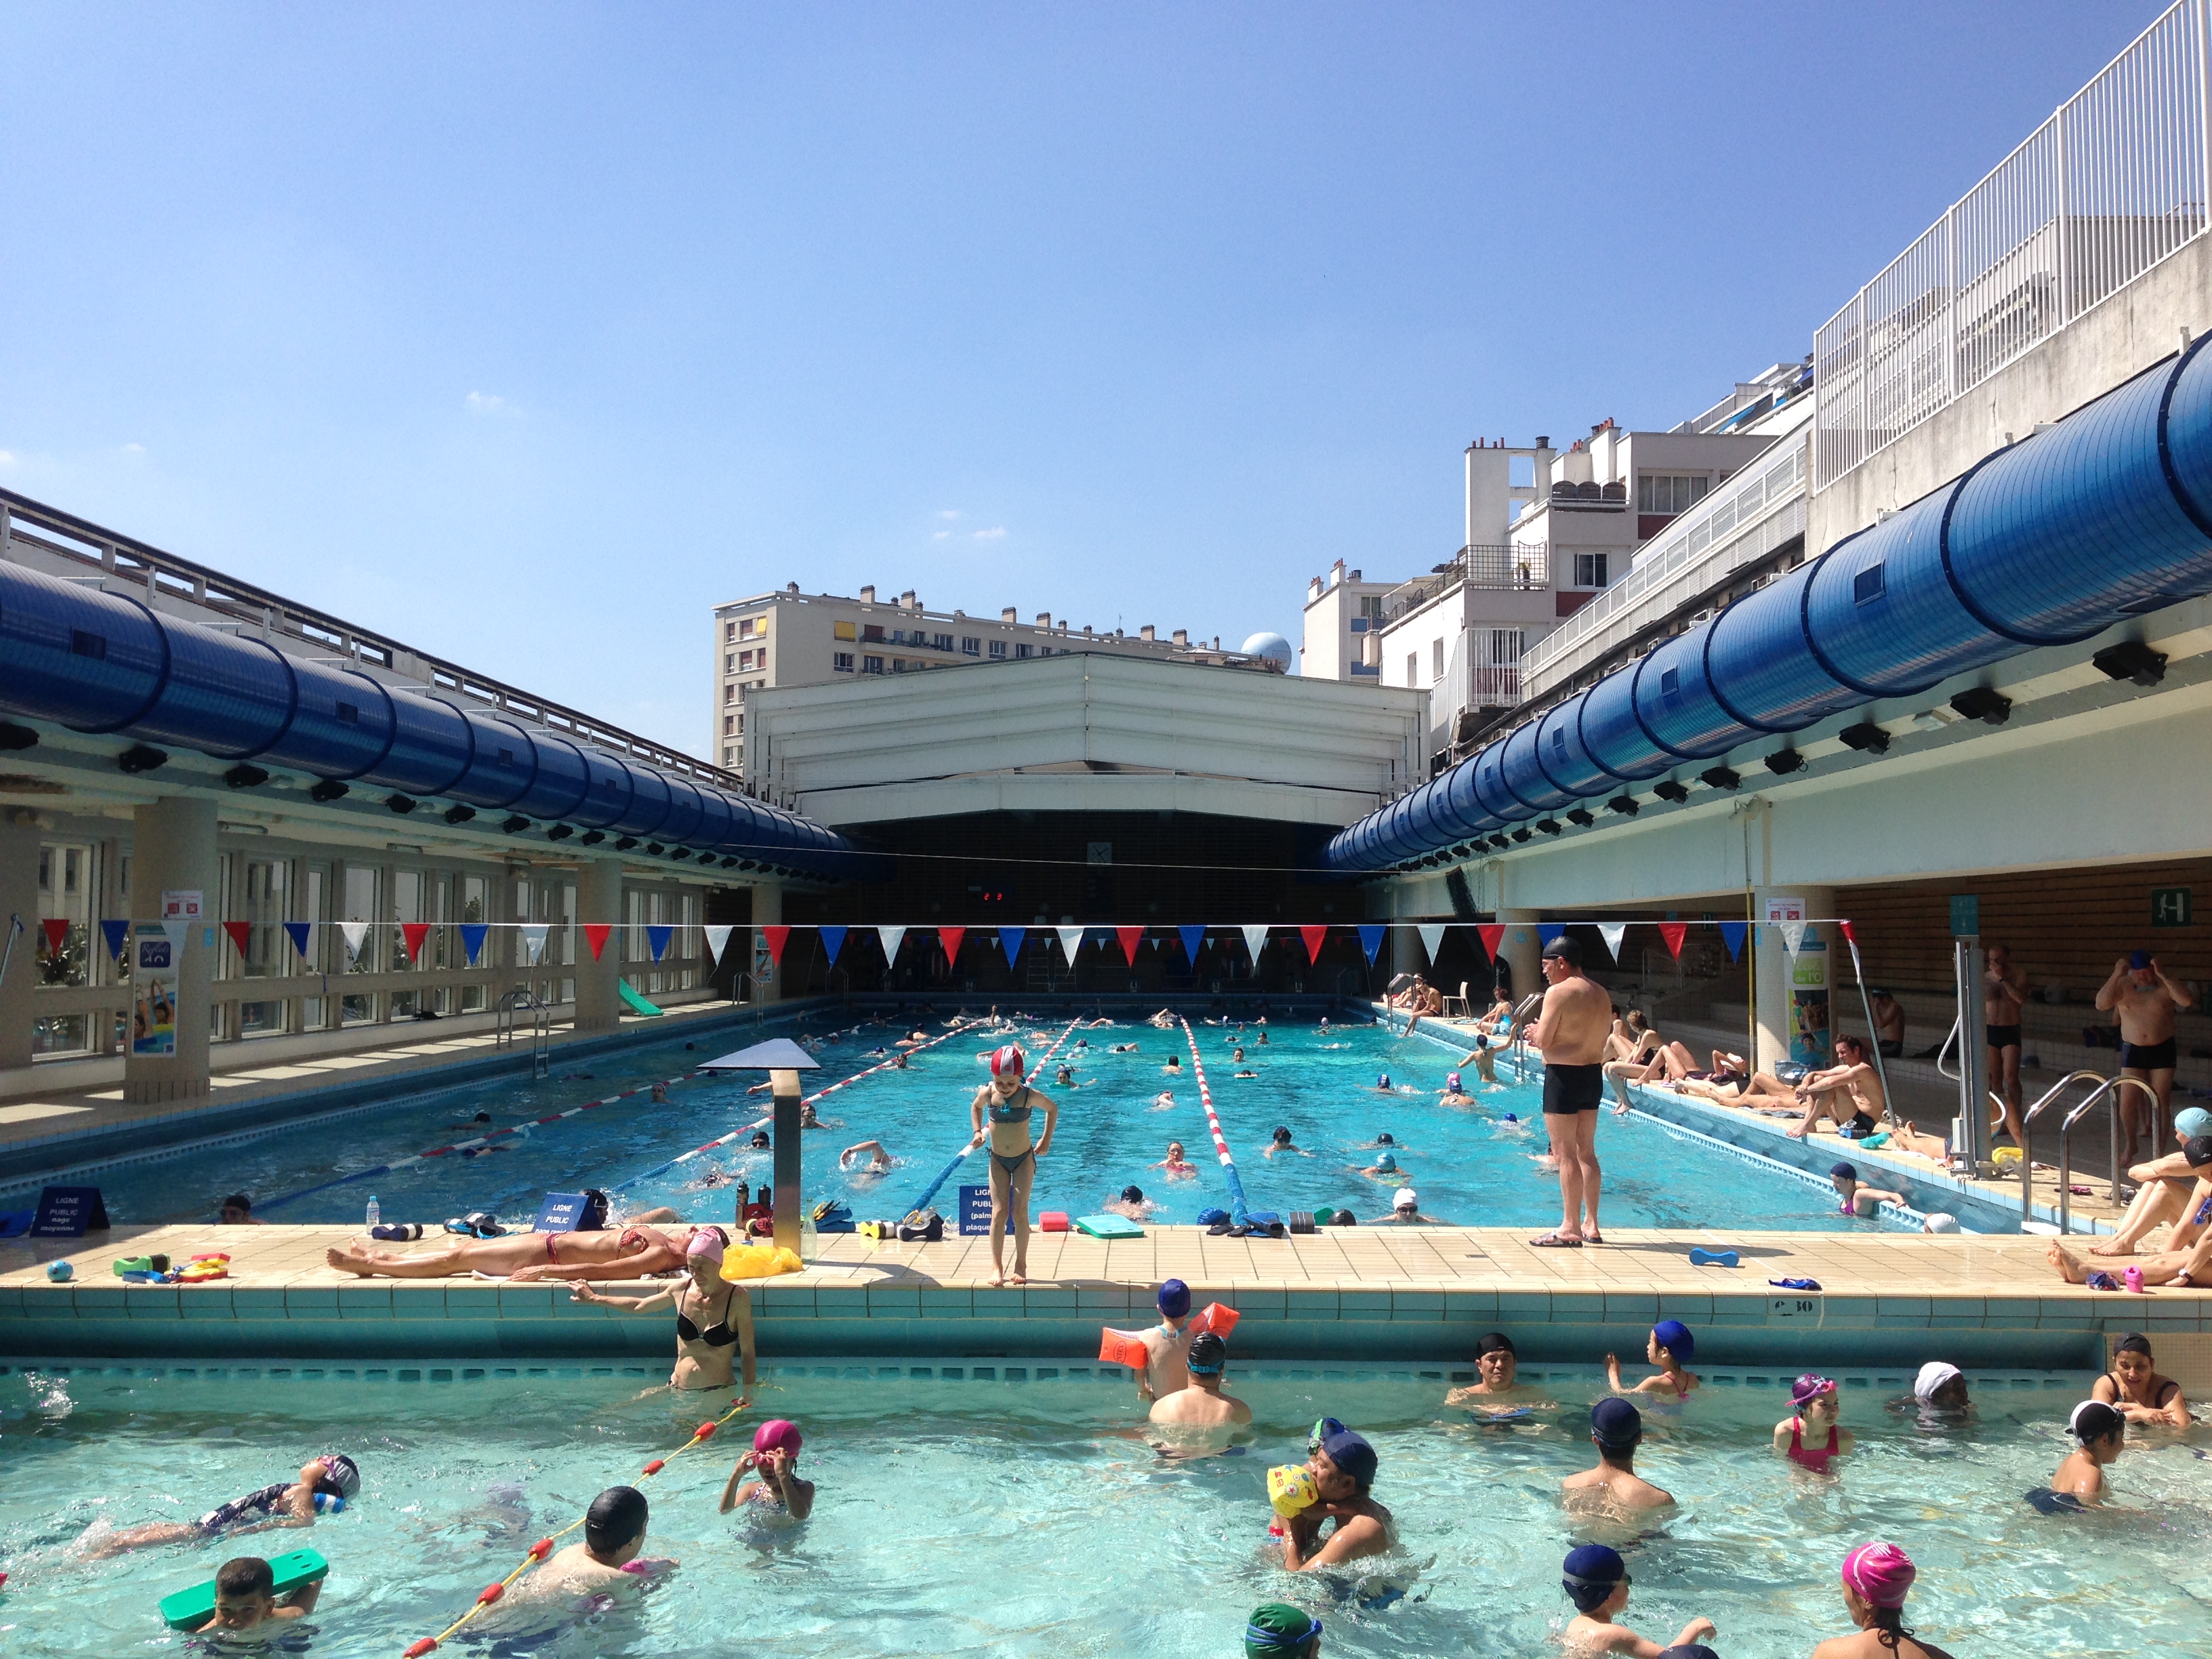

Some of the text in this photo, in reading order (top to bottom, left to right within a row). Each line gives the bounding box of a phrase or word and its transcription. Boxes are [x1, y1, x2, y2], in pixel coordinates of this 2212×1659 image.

[552, 1204, 573, 1212] LIGNE
[545, 1216, 569, 1224] PUBLIC
[970, 1212, 992, 1220] (palm
